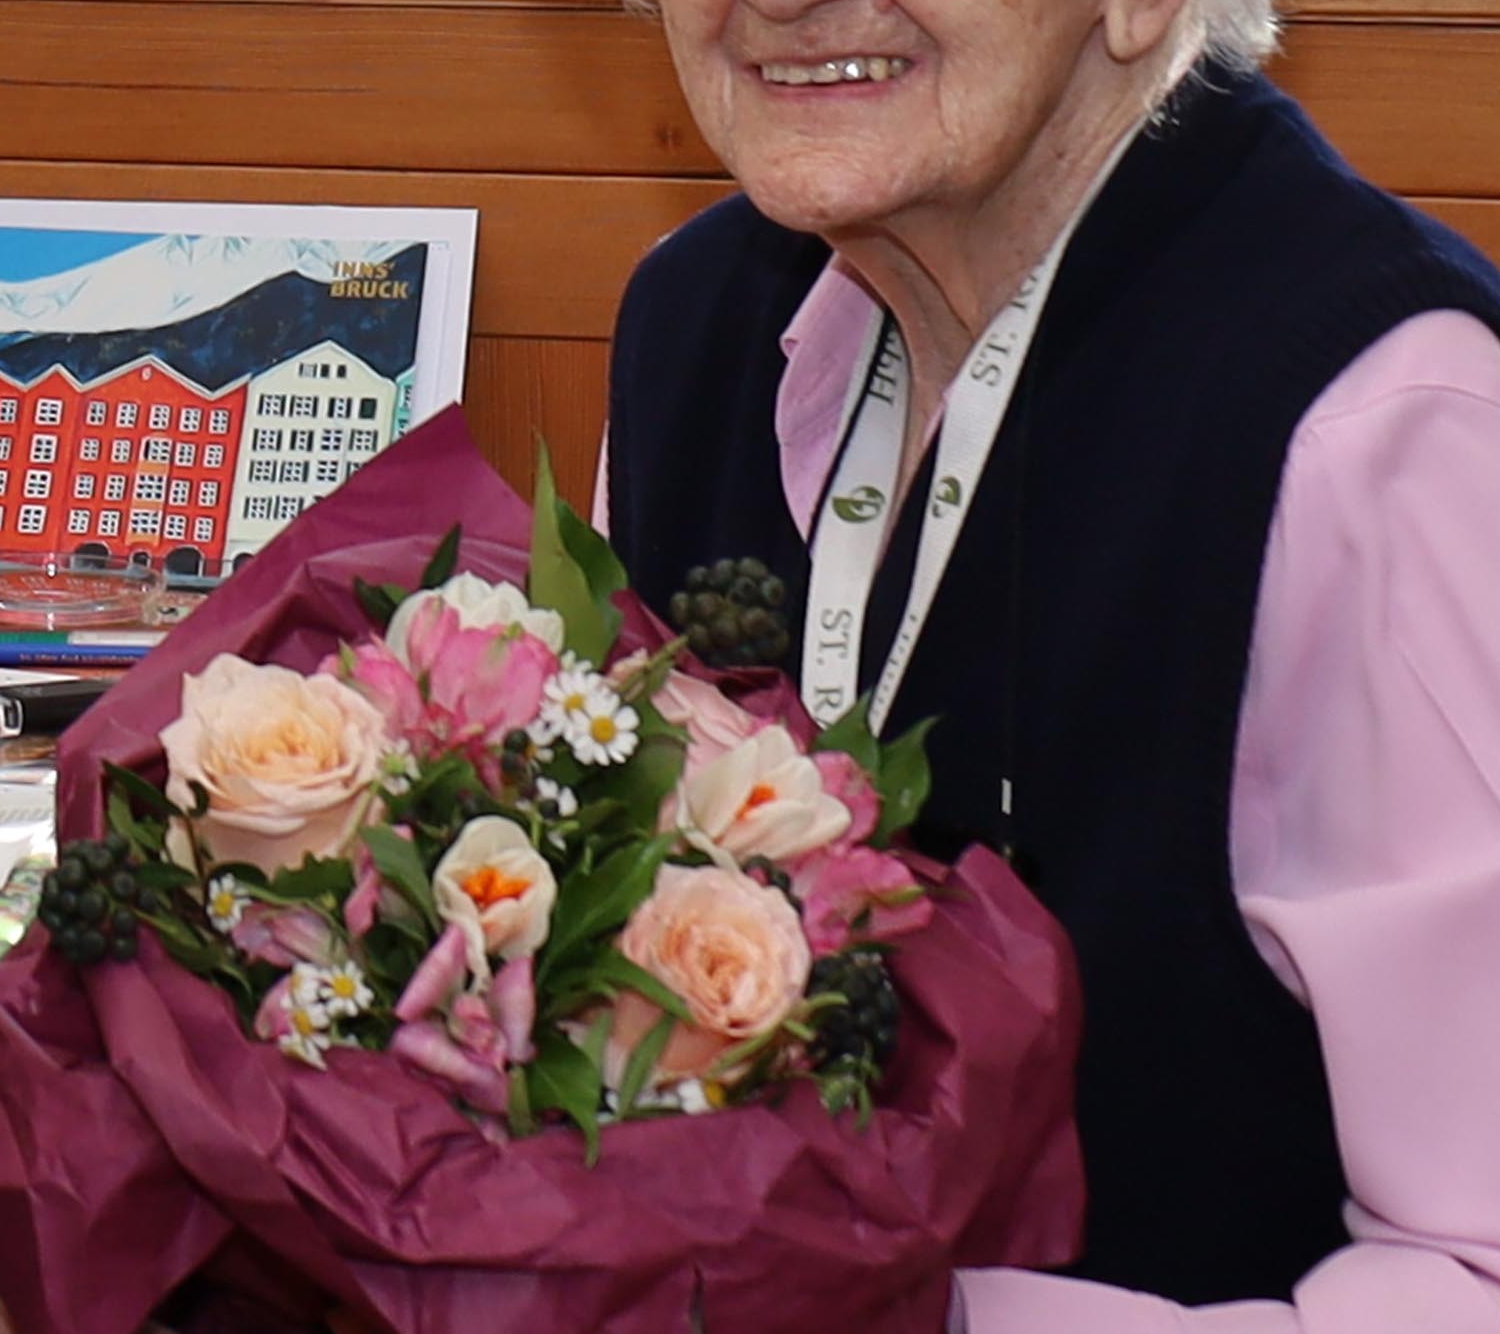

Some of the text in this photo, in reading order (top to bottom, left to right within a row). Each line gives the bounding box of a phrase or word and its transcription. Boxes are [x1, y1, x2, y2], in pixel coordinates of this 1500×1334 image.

[329, 280, 409, 300] BRUCK
[970, 331, 1018, 387] ST.
[815, 608, 853, 666] ST.
